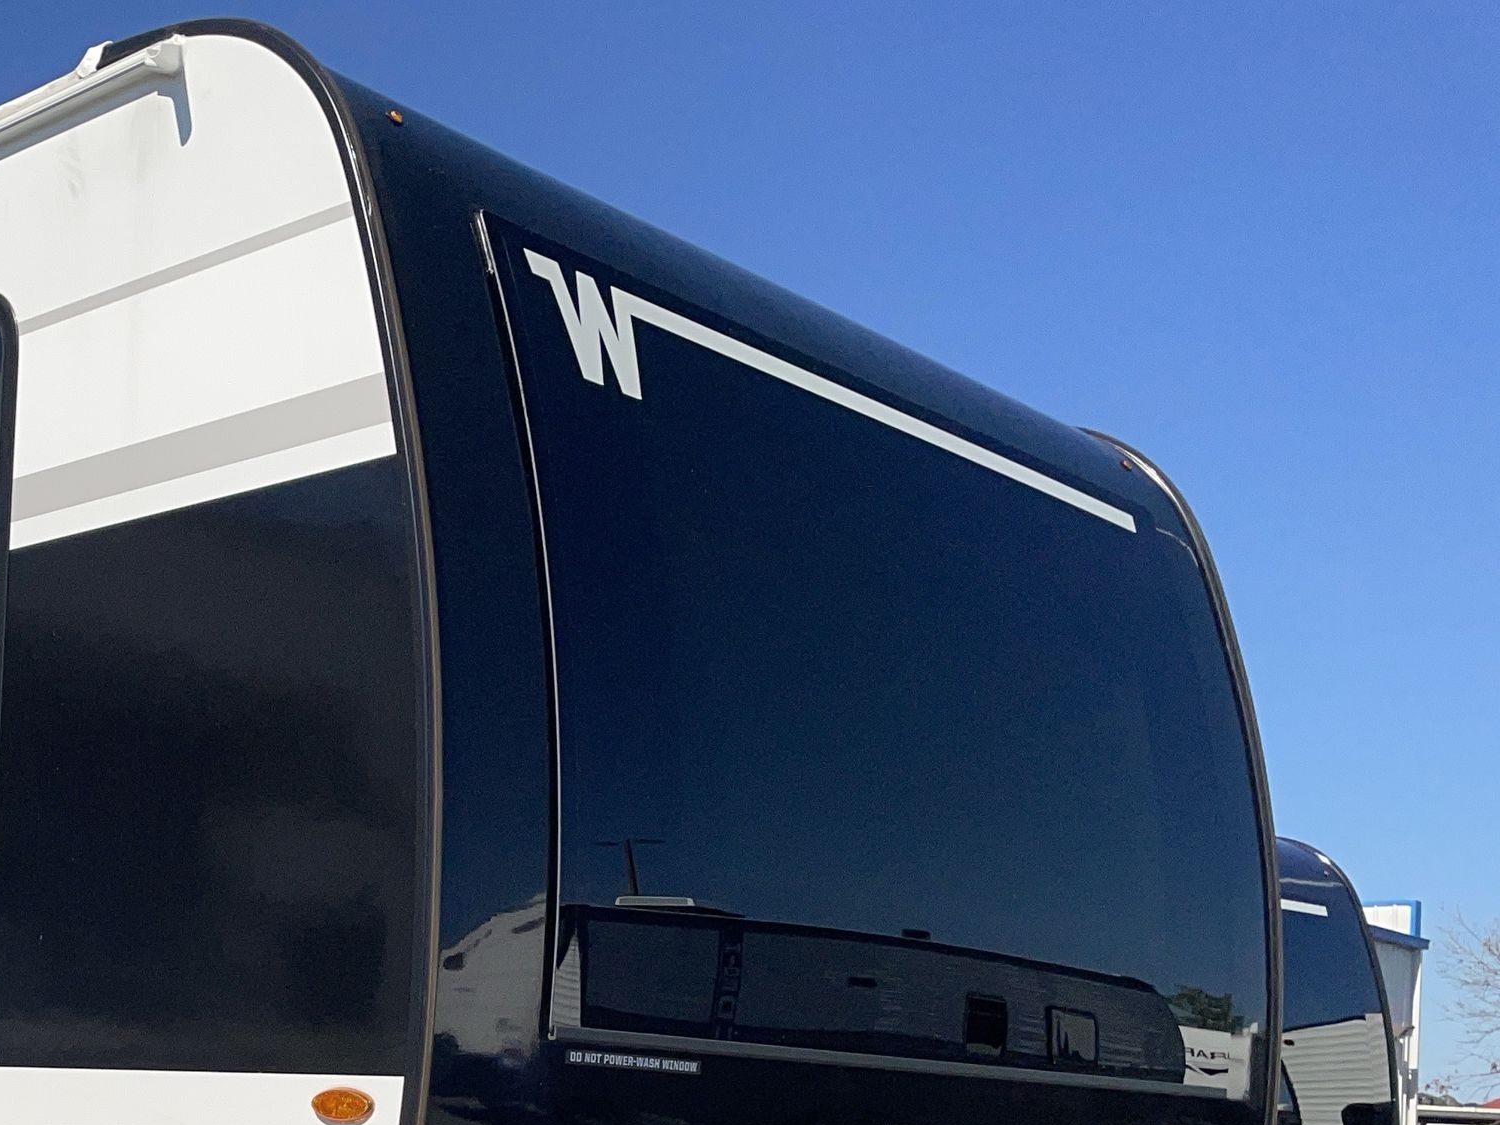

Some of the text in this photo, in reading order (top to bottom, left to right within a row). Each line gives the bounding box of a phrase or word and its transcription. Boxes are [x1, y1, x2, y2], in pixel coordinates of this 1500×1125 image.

[570, 1051, 699, 1072] DO NOT POWER-WASH WINDOW
